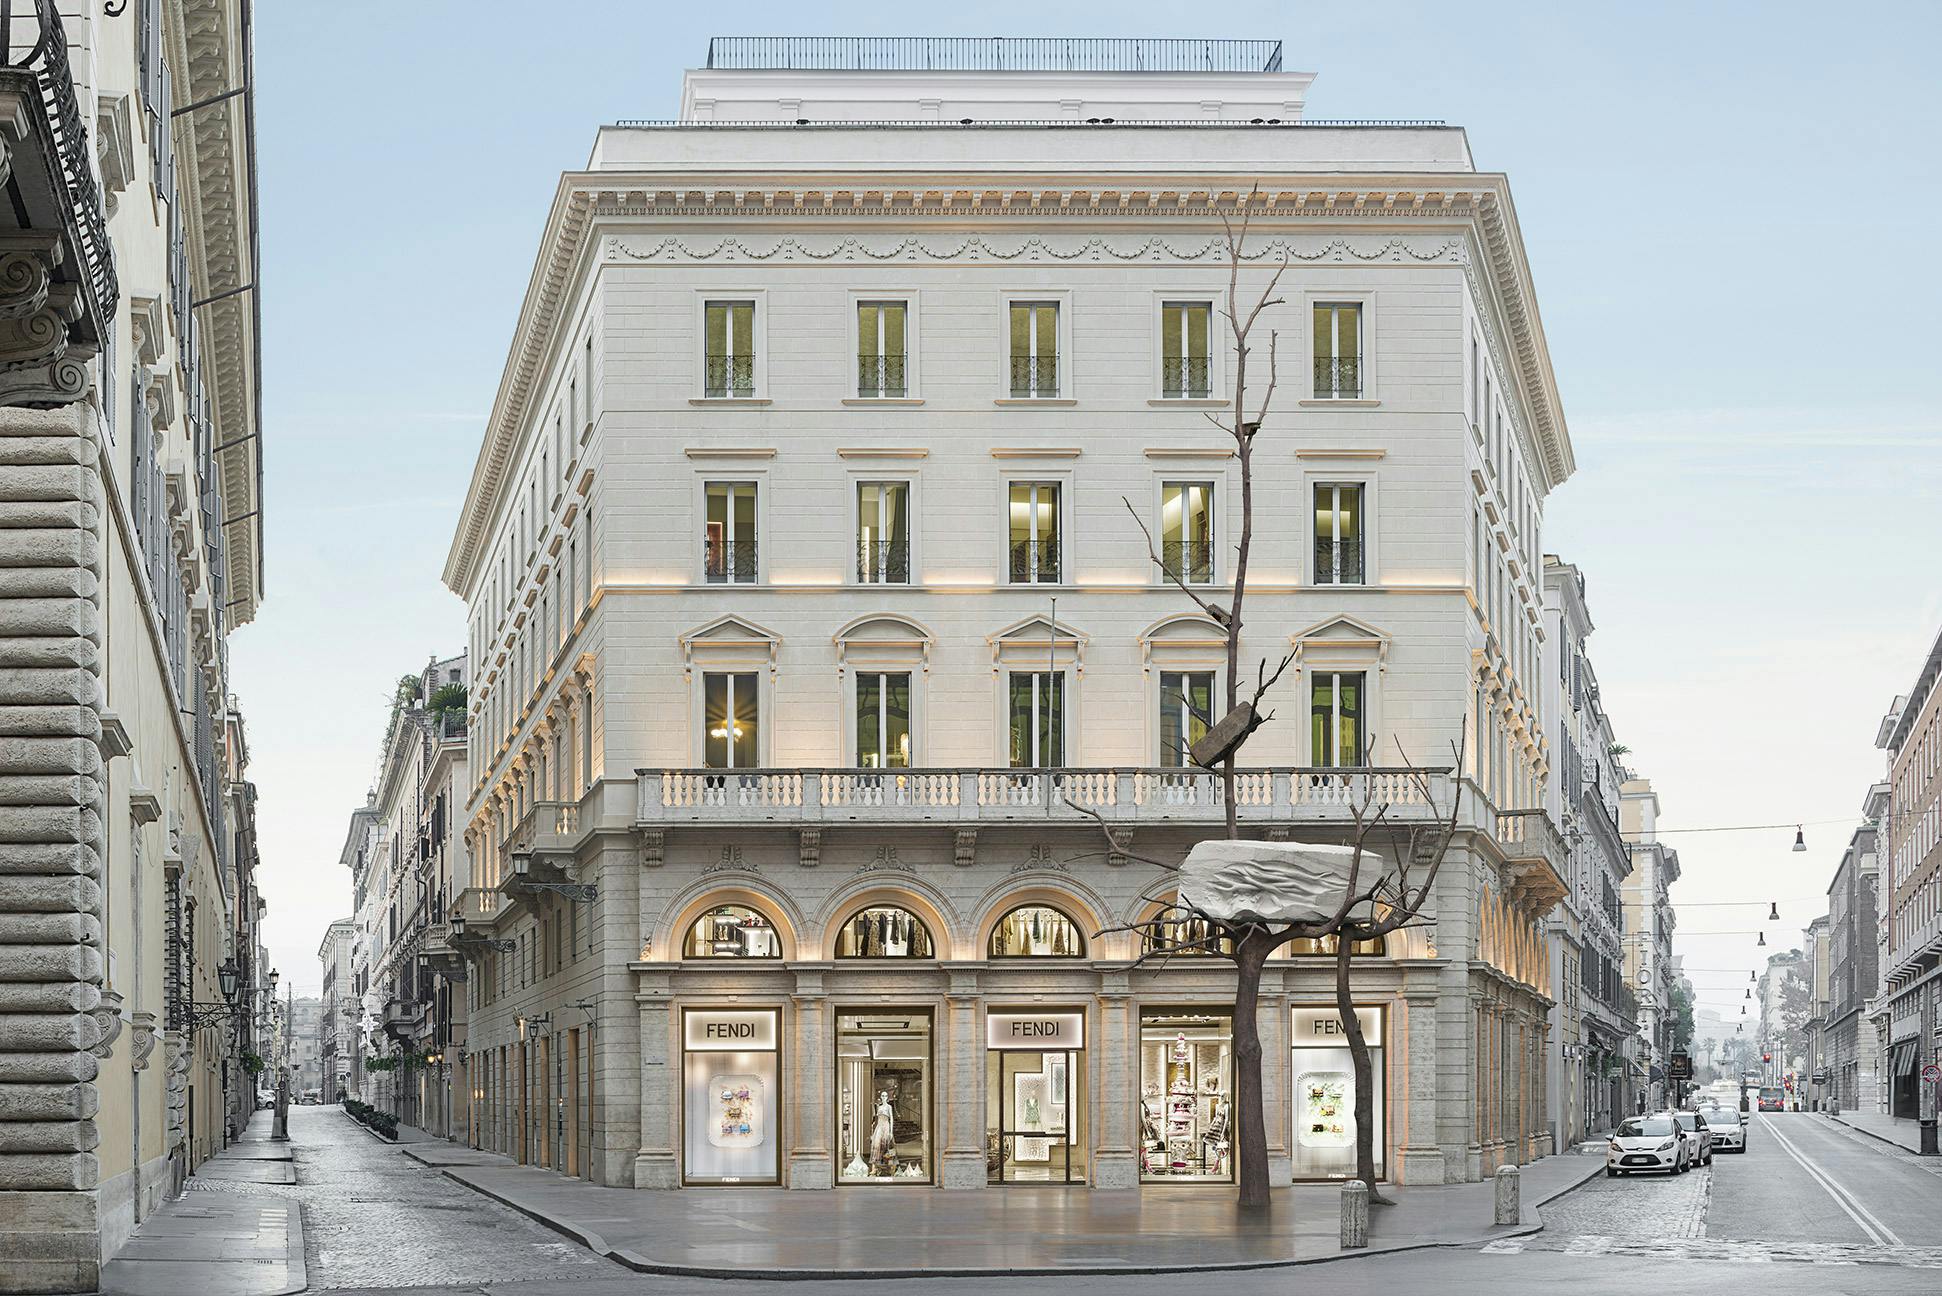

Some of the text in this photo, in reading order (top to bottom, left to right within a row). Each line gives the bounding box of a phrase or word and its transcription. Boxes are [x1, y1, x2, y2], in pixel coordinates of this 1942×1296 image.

[707, 1023, 755, 1038] FENDI
[1012, 1021, 1059, 1036] FENDI
[1314, 1020, 1362, 1034] FENI
